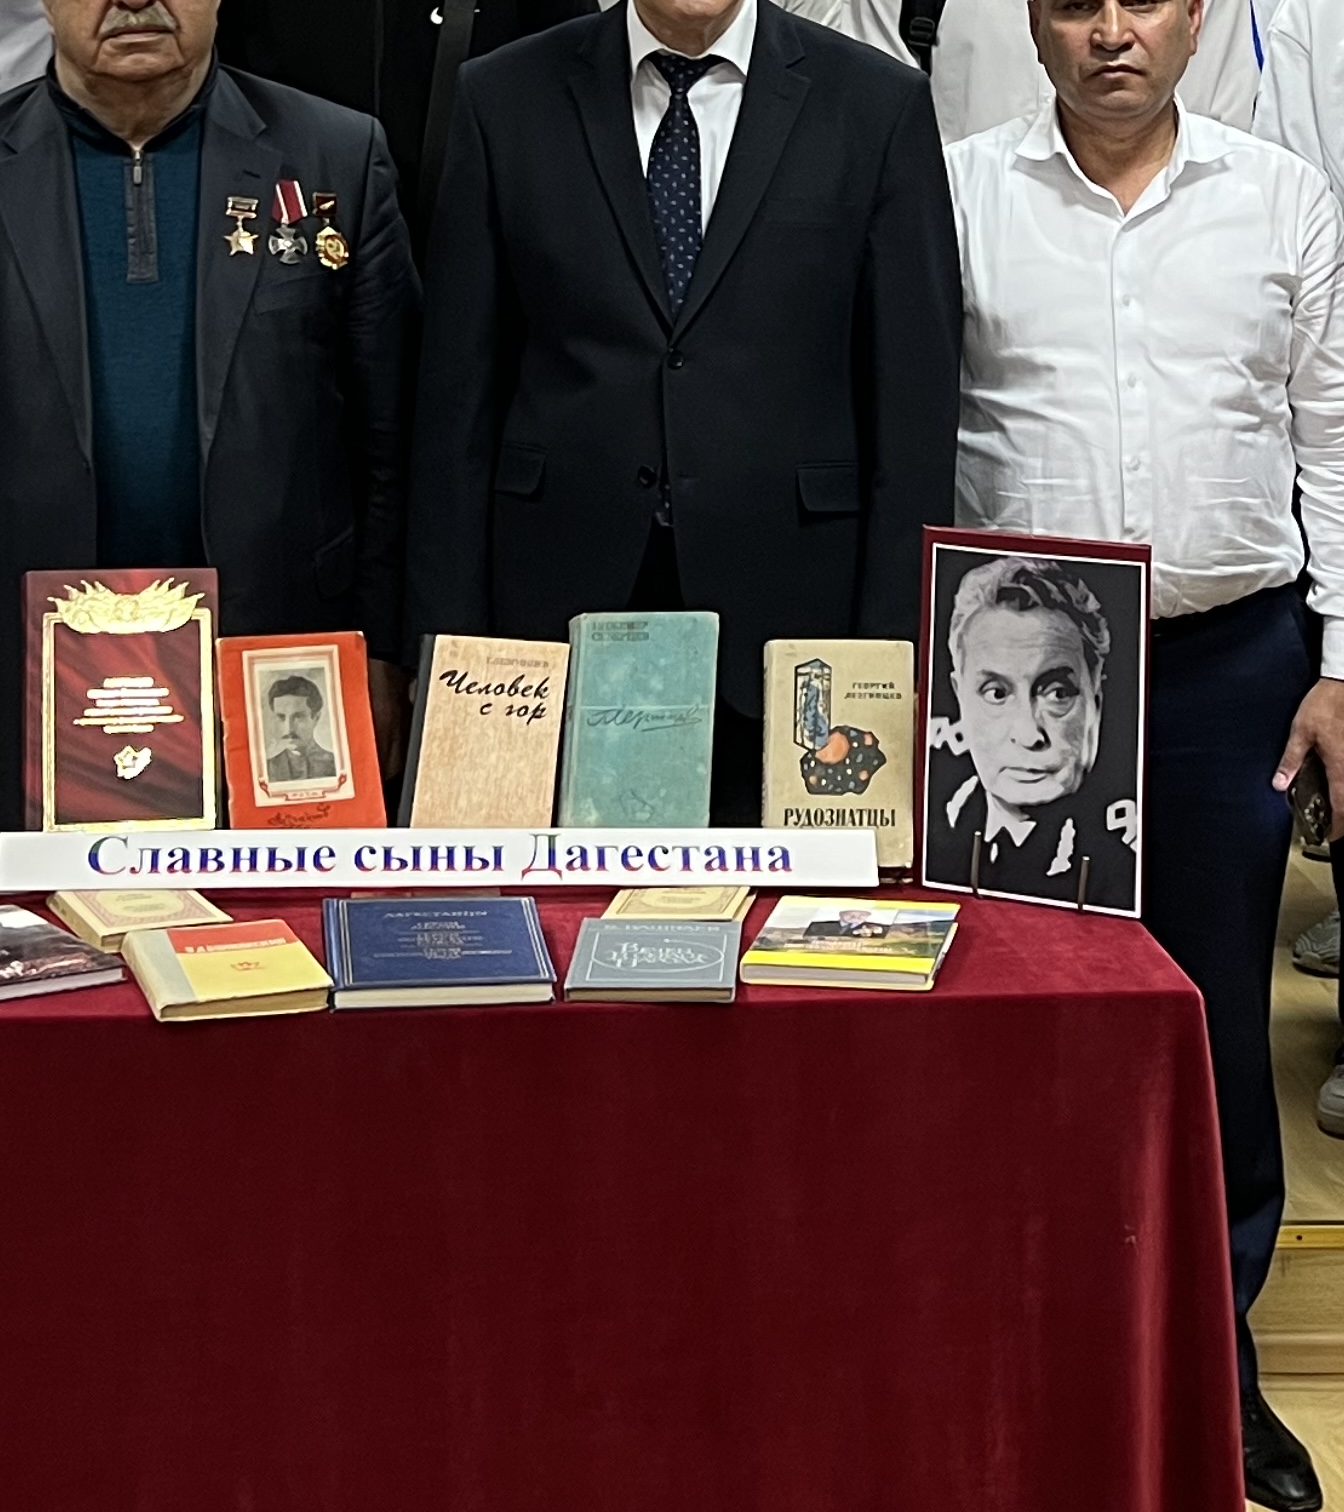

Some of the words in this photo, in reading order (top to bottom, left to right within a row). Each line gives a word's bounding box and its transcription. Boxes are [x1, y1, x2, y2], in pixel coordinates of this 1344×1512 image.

[439, 670, 550, 699] Человек
[480, 703, 492, 715] с
[505, 702, 547, 725] гор
[783, 807, 896, 830] РУДОЗНАТЦЫ
[87, 836, 337, 875] Славные
[354, 844, 504, 873] сыны
[521, 833, 793, 881] Дагестана
